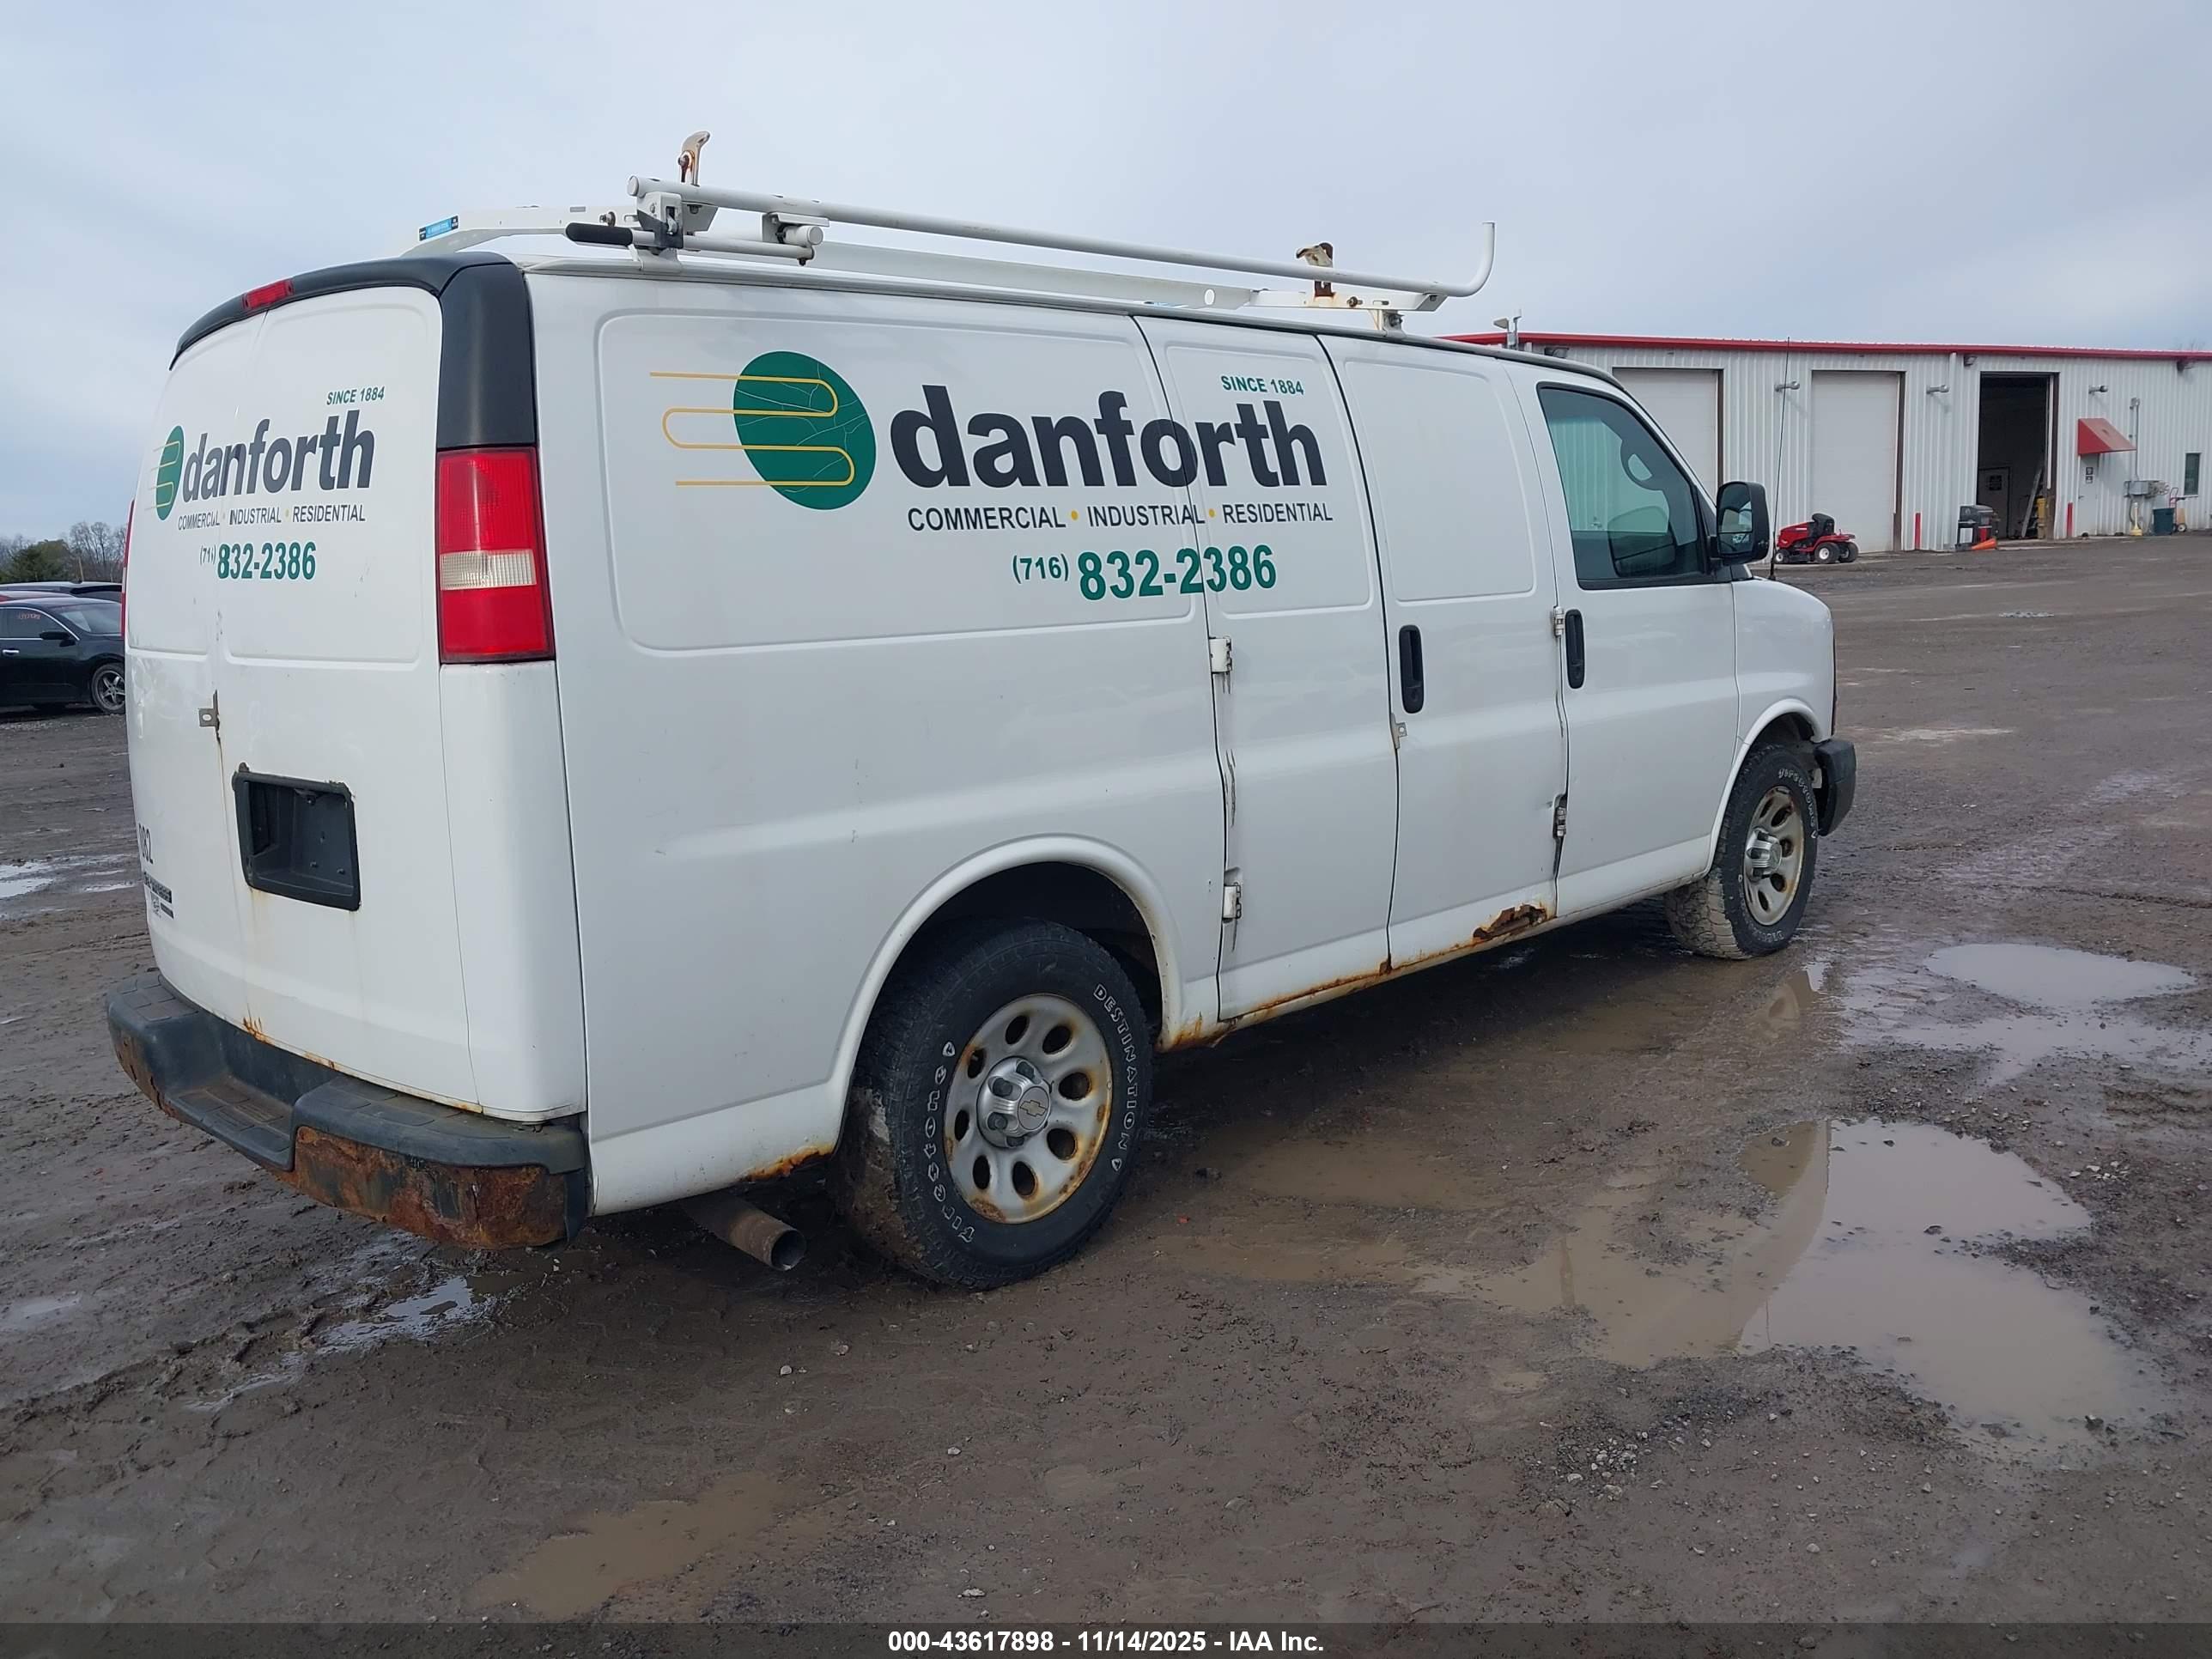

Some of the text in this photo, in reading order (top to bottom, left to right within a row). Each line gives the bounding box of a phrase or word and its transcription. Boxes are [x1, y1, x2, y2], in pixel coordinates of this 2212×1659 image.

[326, 386, 385, 405] SINCE 1884
[1220, 375, 1304, 396] SINCE 1884
[890, 384, 1328, 488] danforth
[183, 410, 375, 502] danforth
[229, 507, 282, 526] INDUSTRIAL
[293, 504, 366, 523] RESIDENTIAL
[908, 502, 1333, 531] COMMERCIAL INDUSTRIAL RESIDENTIAL
[217, 542, 317, 580] 832-2386
[1012, 544, 1277, 600] (716) 832-2386
[1093, 983, 1139, 1152] DESTINATION
